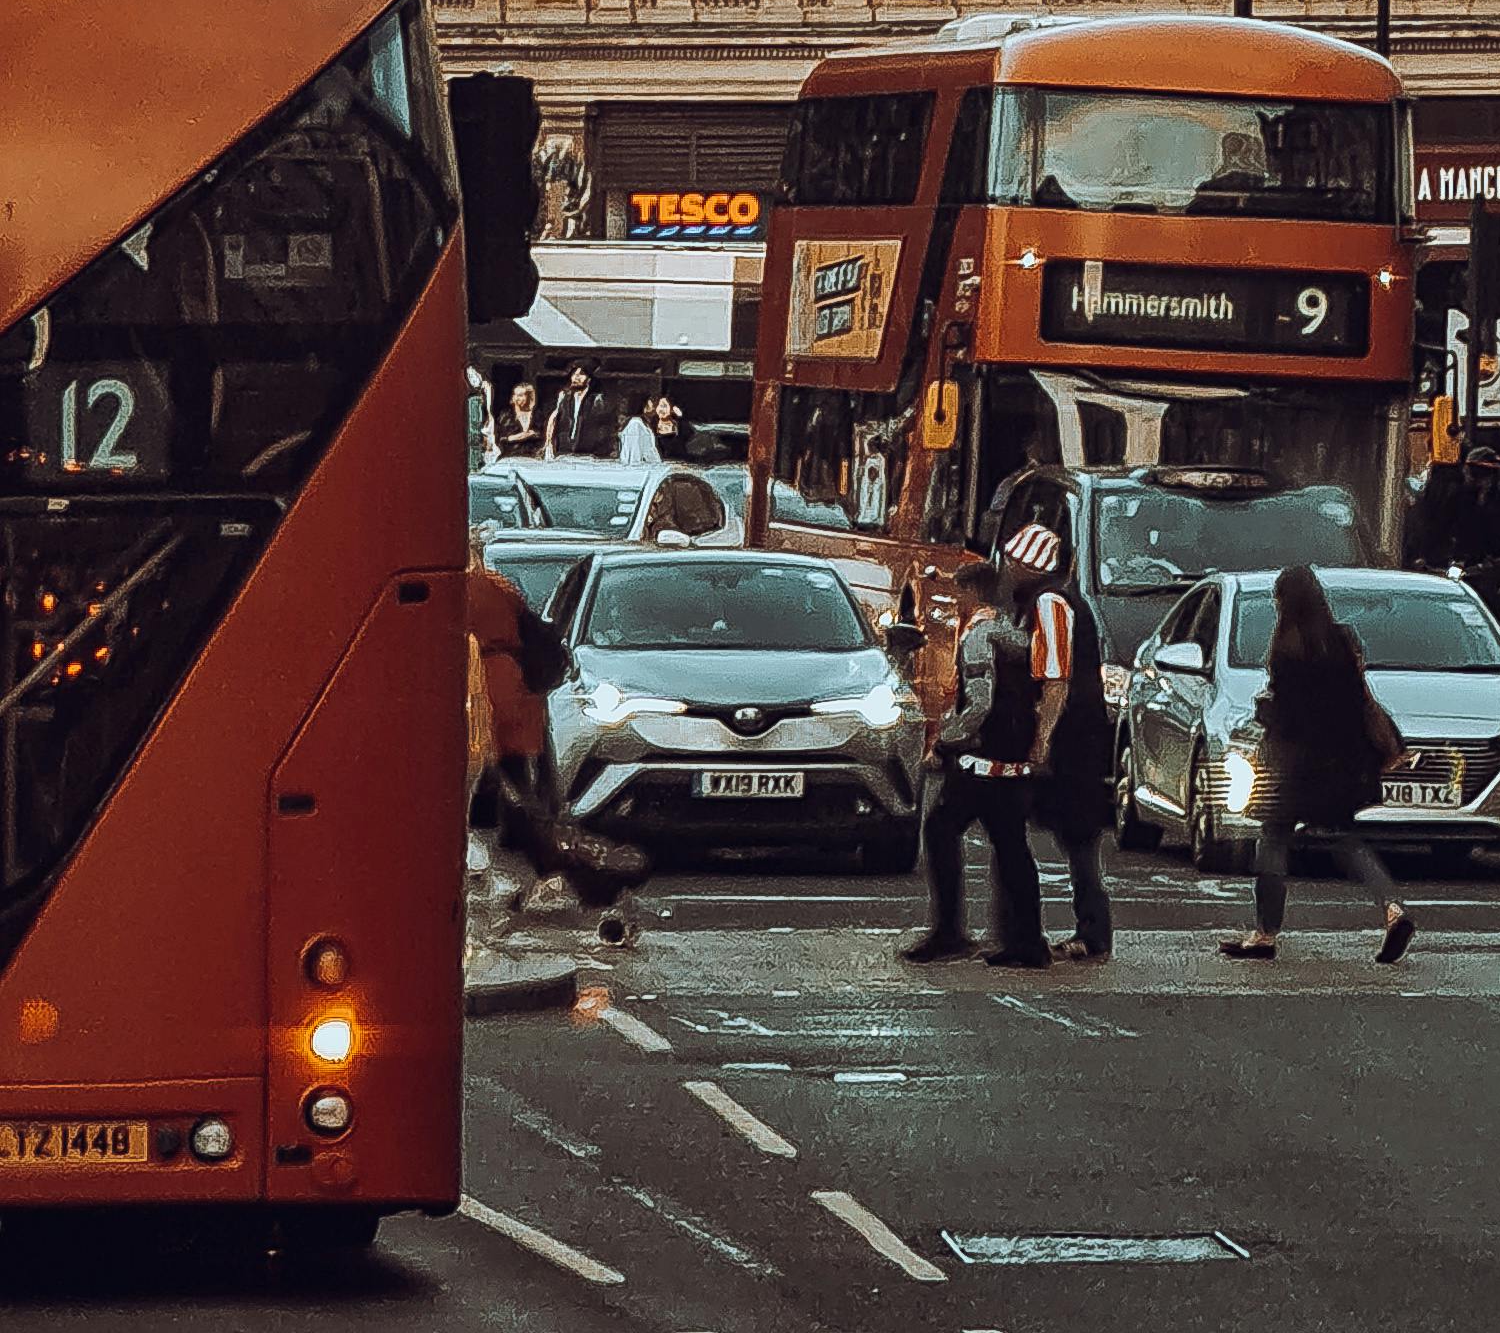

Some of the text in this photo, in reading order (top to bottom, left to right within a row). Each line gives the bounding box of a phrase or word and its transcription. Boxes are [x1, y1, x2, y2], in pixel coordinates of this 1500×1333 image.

[1416, 166, 1432, 201] A
[630, 192, 759, 225] TESCO
[1071, 284, 1234, 321] Hammersmith
[1297, 286, 1329, 335] 9
[62, 379, 138, 470] 12
